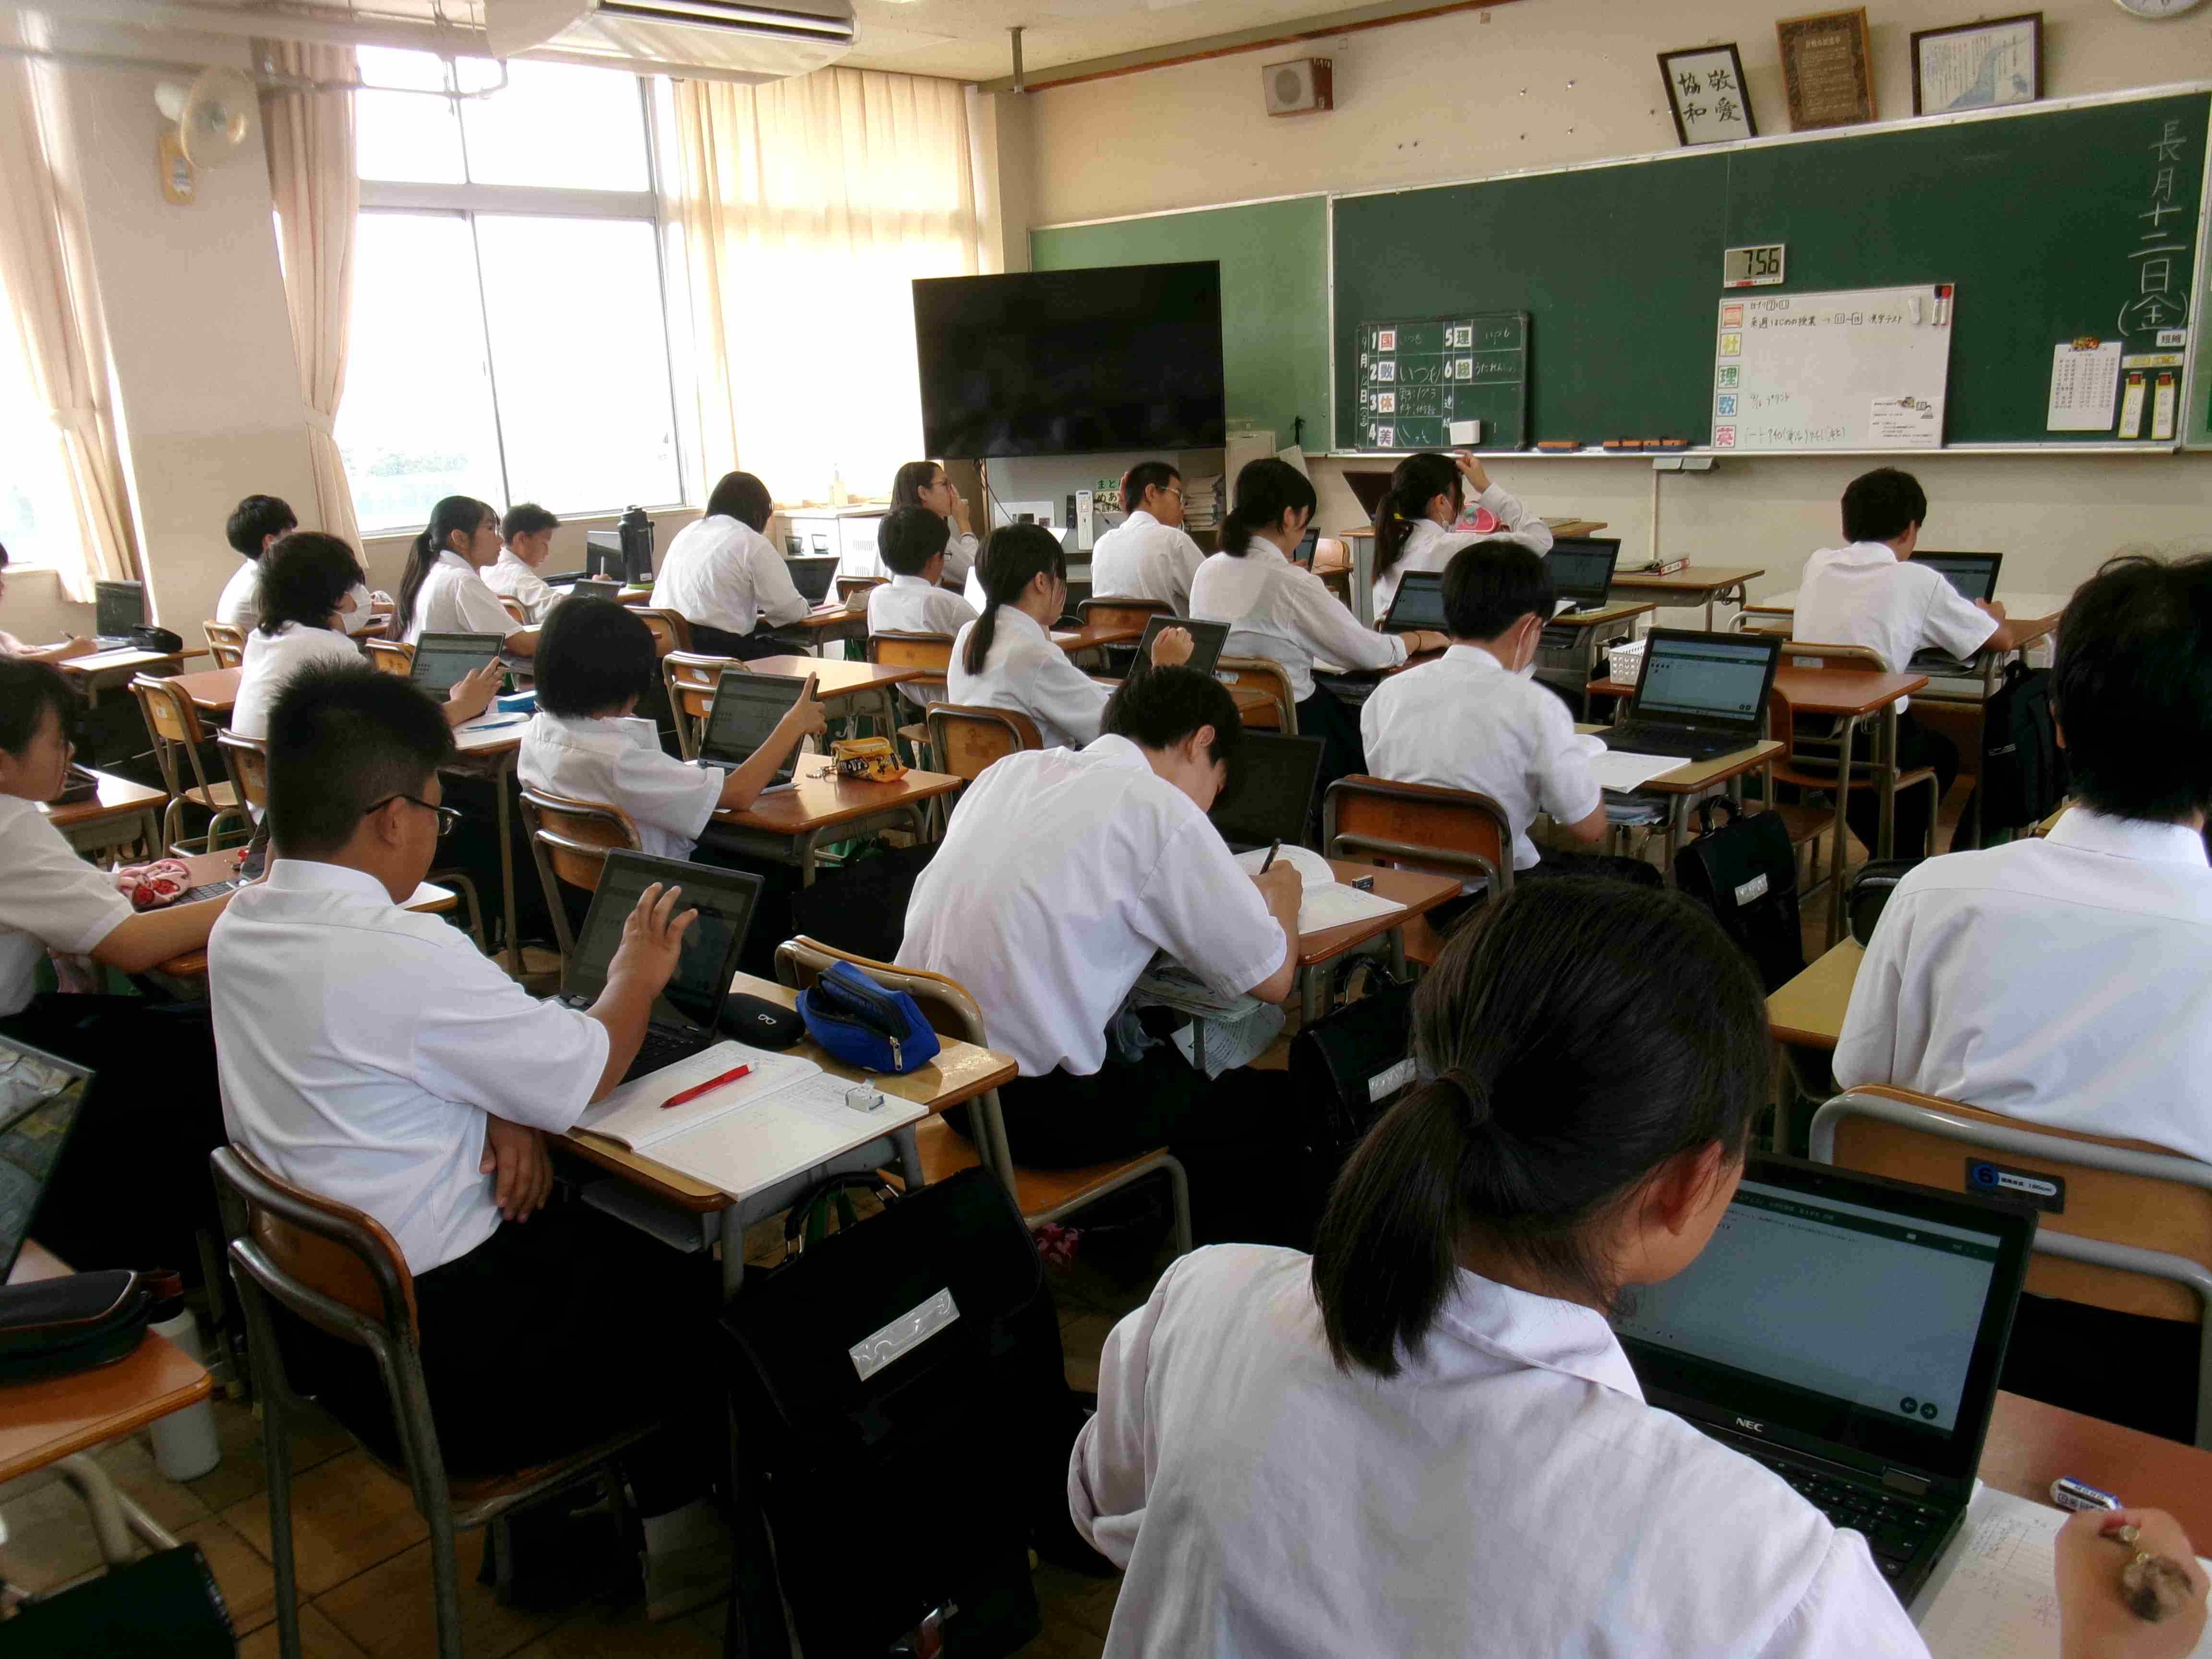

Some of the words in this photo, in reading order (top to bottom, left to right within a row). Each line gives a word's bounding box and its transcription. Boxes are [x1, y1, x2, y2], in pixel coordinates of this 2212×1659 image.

[1677, 72, 1707, 124] 協和
[1707, 69, 1741, 122] 敬愛
[1371, 332, 1377, 350] 1
[1444, 328, 1453, 347] 5
[1456, 329, 1470, 345] 理
[1370, 363, 1377, 381] 2
[1381, 363, 1394, 380] 数
[1444, 361, 1452, 378] 6
[1720, 367, 1737, 386] 理
[1370, 394, 1377, 411] 3
[1381, 395, 1393, 411] 体
[1719, 396, 1735, 415] 数
[1369, 423, 1376, 441] 4
[1380, 429, 1392, 445] 美
[1717, 426, 1733, 446] 英
[1098, 480, 1120, 490] まと
[1098, 492, 1120, 502] めあ
[1978, 1167, 1994, 1183] 6
[1736, 1417, 1763, 1432] NEC
